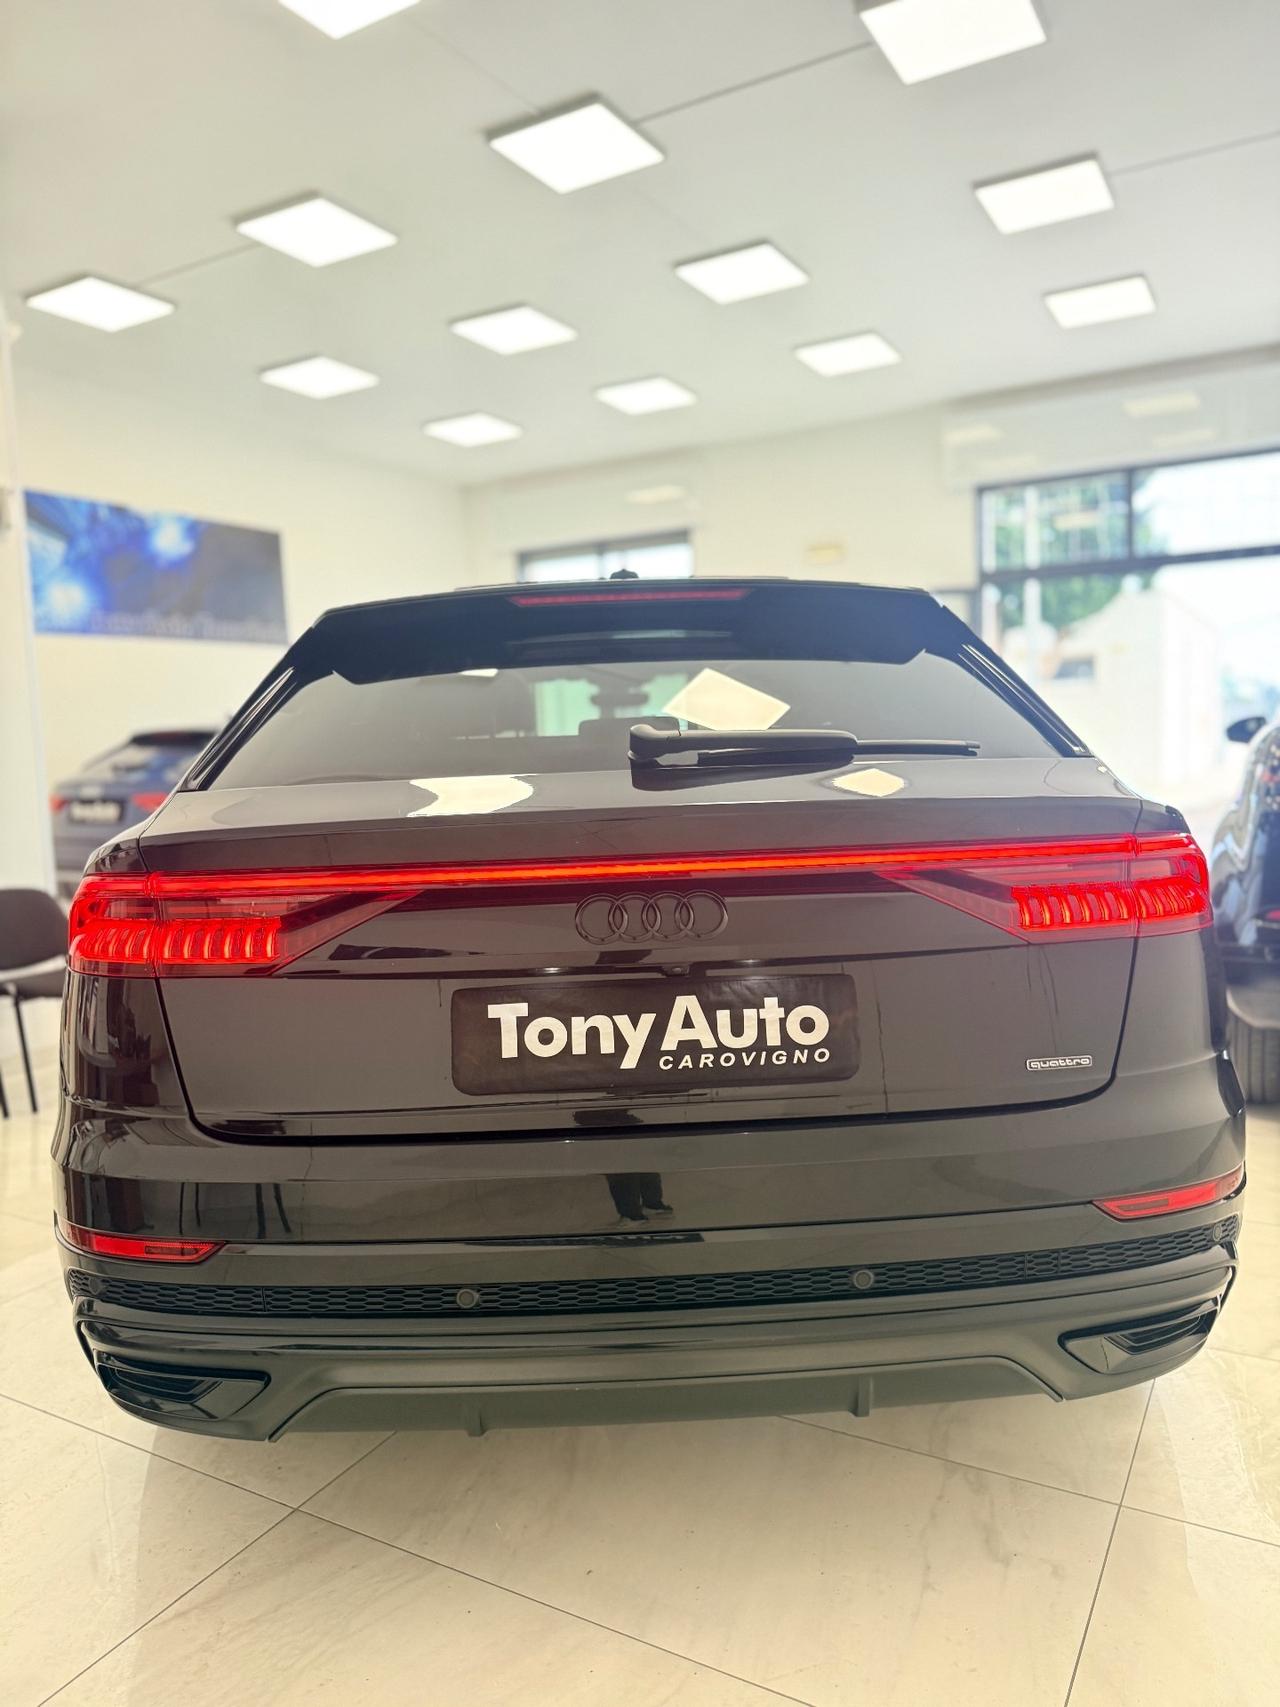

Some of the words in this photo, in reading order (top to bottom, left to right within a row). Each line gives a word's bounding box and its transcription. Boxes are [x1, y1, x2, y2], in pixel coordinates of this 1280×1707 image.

[488, 1002, 656, 1070] Tony
[660, 995, 830, 1051] Auto
[658, 1048, 831, 1071] CAROVIGNO
[1029, 1057, 1090, 1070] quattro
